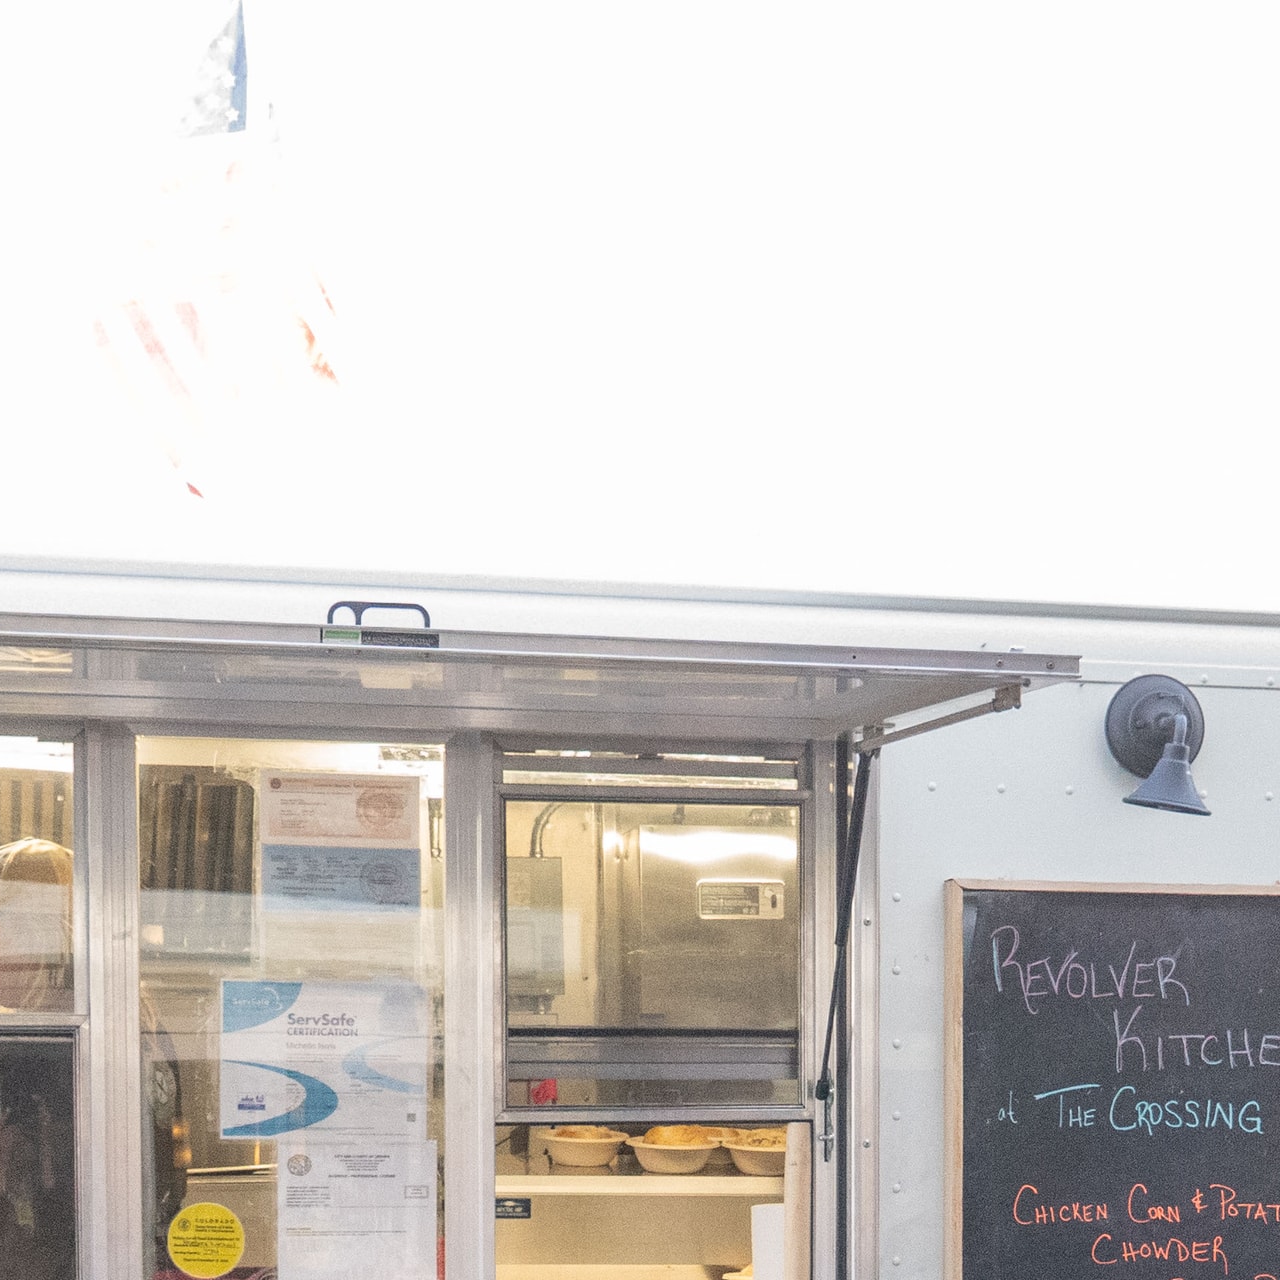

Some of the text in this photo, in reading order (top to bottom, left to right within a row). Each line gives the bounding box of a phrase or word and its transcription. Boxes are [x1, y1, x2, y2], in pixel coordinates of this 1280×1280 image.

[991, 925, 1189, 1014] REVOLVER
[287, 1013, 354, 1026] ServSafe
[287, 1027, 358, 1036] CERTIFICATION
[997, 1084, 1264, 1135] at THE CROSSING
[1013, 1185, 1109, 1225] CHICKEN
[1127, 1184, 1181, 1224] CORN
[1091, 1233, 1229, 1275] CHOWDER
